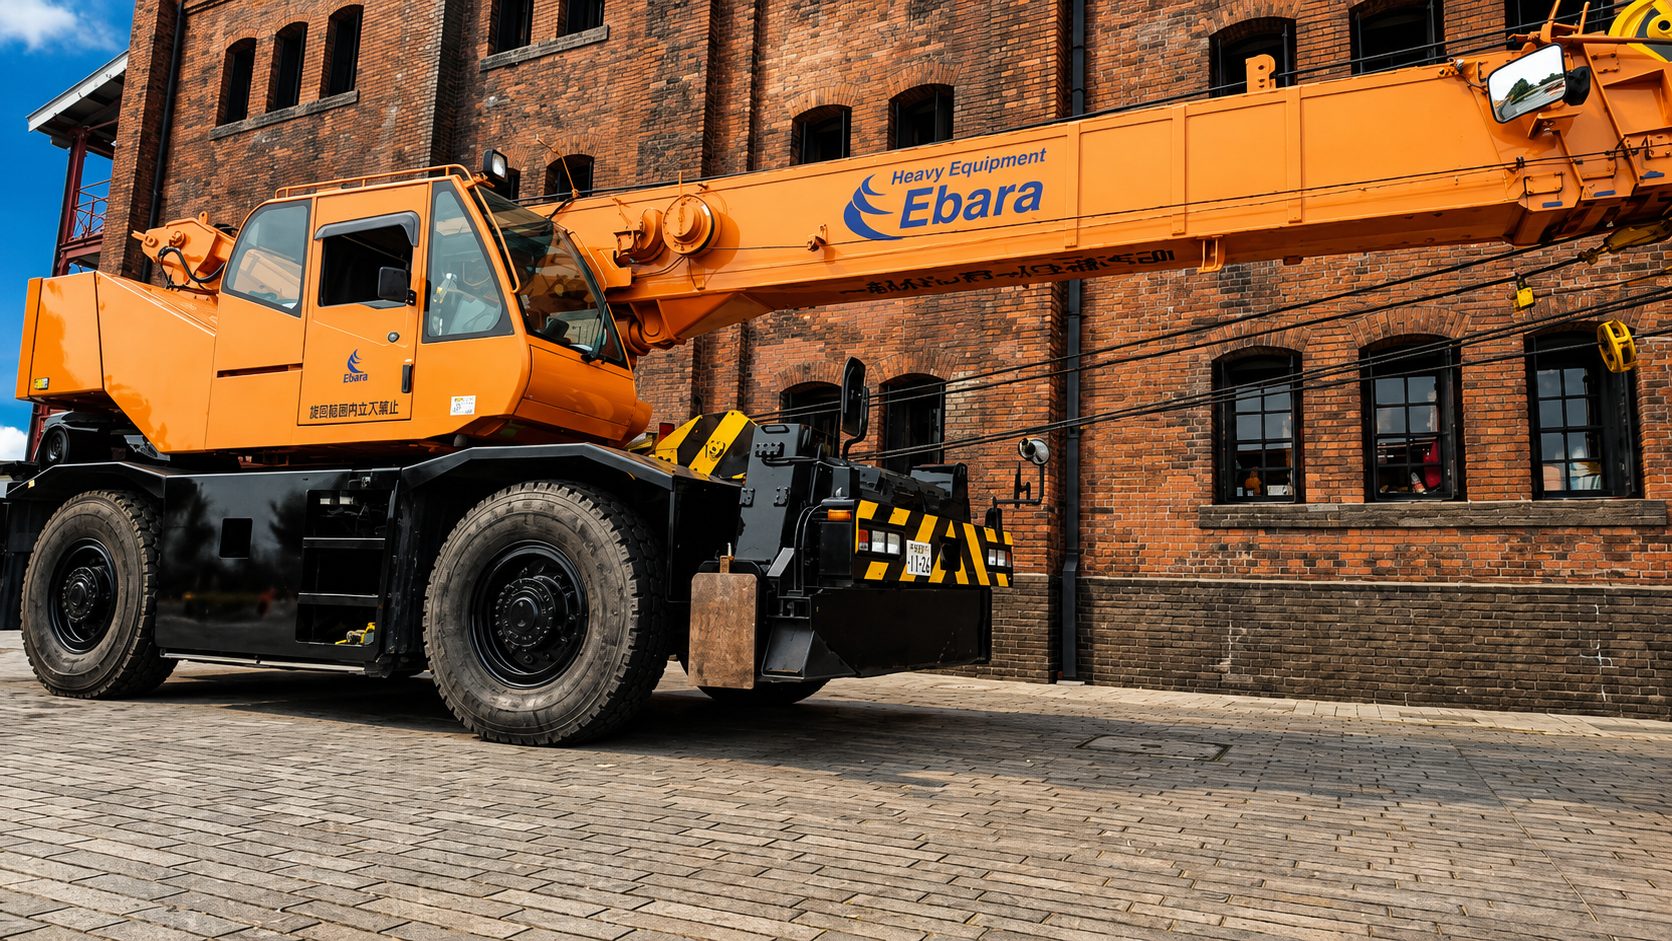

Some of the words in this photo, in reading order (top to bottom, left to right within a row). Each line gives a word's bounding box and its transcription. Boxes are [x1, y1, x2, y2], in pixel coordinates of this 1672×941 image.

[891, 167, 945, 185] Heavy
[948, 148, 1047, 178] Equipment
[899, 180, 1044, 229] Ebara
[343, 373, 368, 383] Ebara
